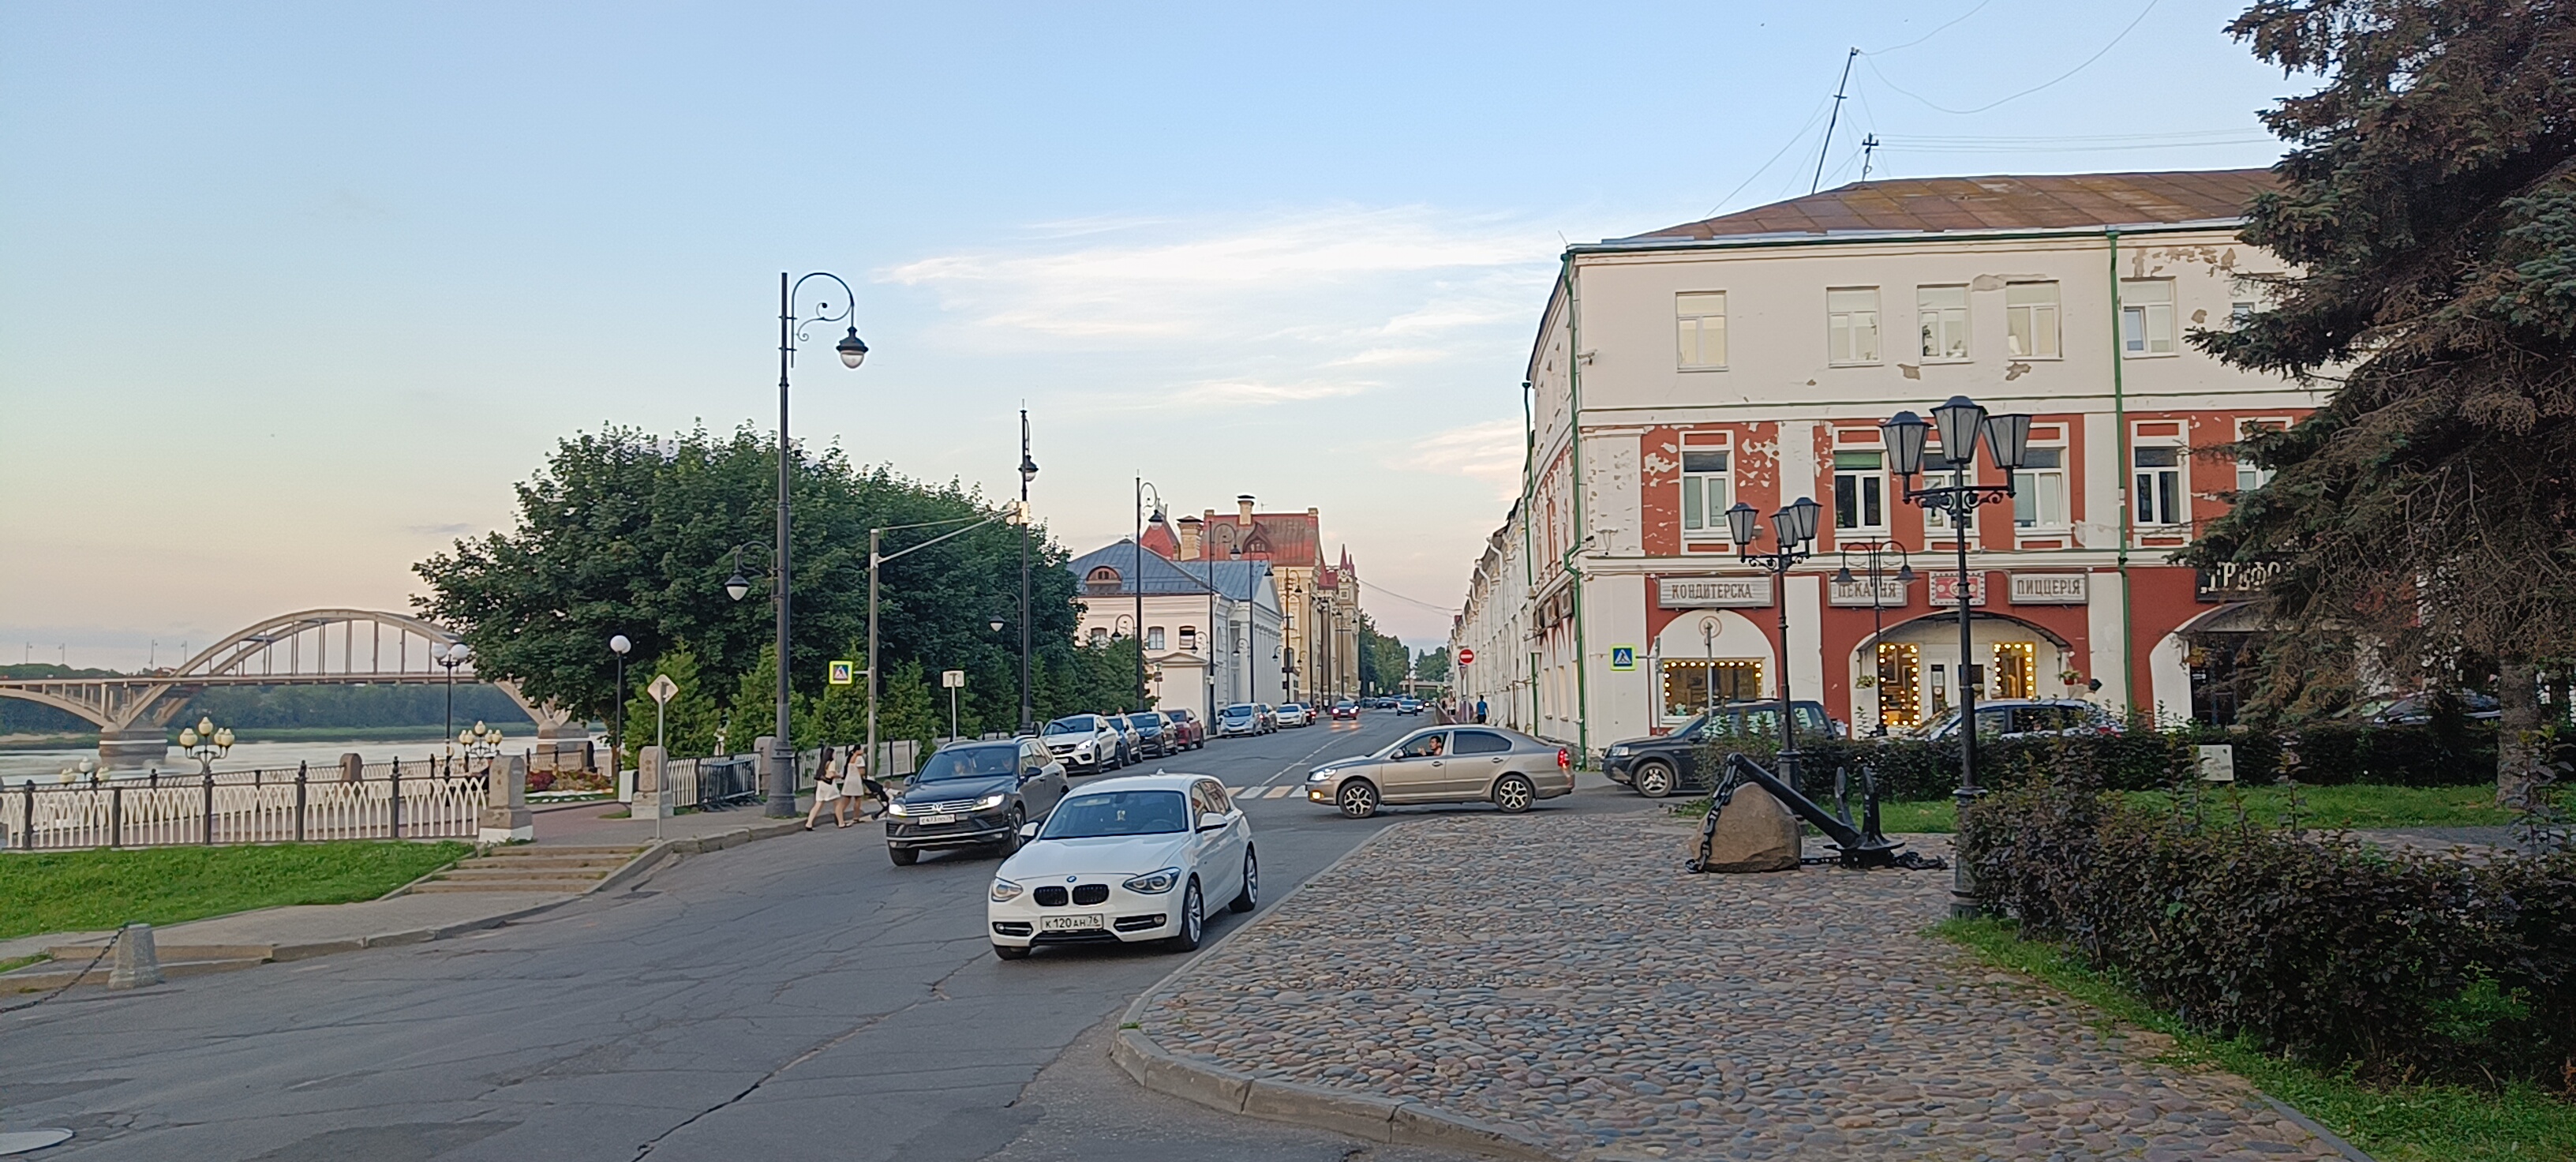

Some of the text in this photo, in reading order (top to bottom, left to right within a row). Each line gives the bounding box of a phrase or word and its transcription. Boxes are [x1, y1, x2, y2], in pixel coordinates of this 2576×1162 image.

[1671, 583, 1753, 600] КОНДИТЕРСКА
[1838, 582, 1896, 598] ПЕКАНЯ
[2016, 579, 2081, 597] ПИЦЦЕРІЯ
